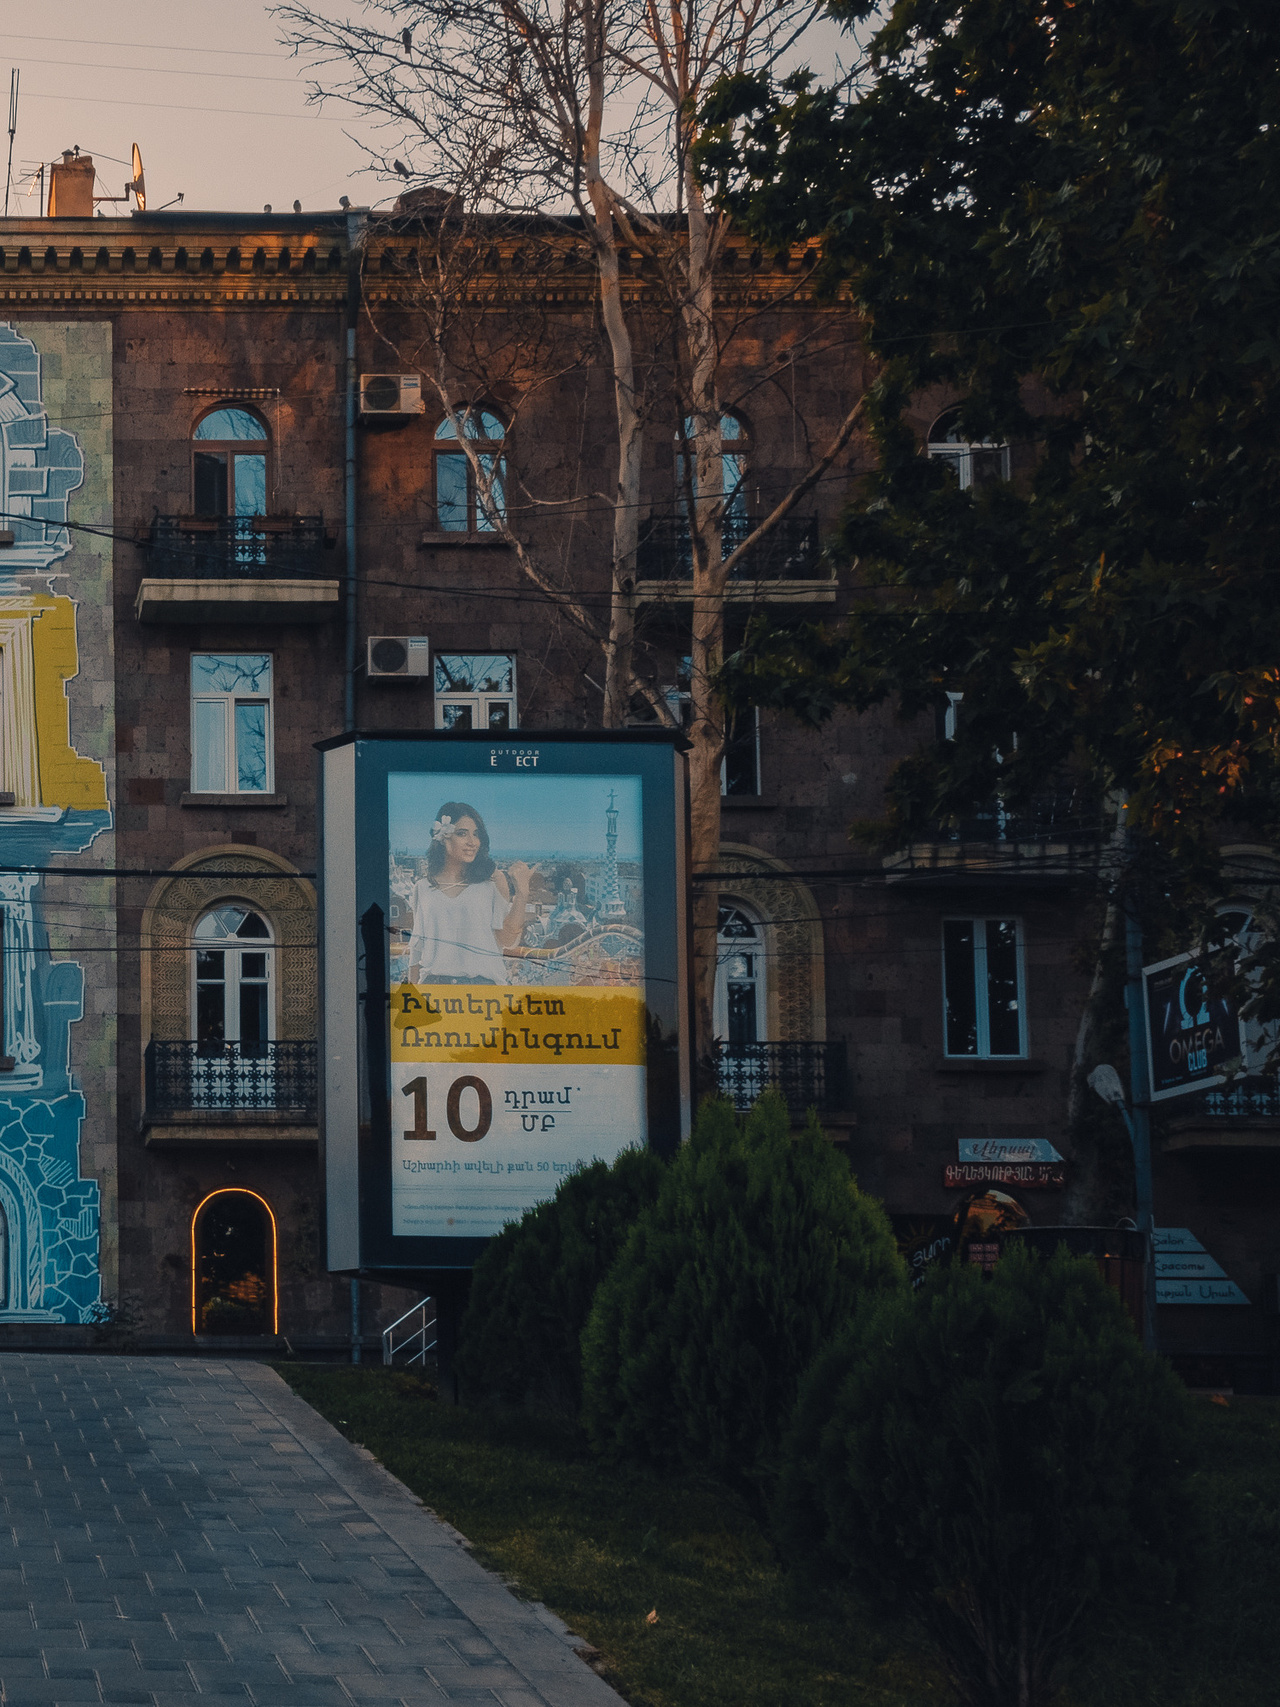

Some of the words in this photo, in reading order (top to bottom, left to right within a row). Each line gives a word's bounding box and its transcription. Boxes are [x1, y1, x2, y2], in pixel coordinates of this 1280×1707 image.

[401, 993, 565, 1021] Ինտերնետ
[400, 1025, 622, 1055] Ռոումինգում
[1169, 1026, 1225, 1064] OMEGA
[1187, 1048, 1208, 1072] CLUB
[401, 1075, 493, 1142] 10
[521, 1114, 555, 1132] ՄԲ
[402, 1160, 460, 1173] Աշխարհի
[464, 1160, 504, 1173] ավելի
[507, 1161, 533, 1174] քան
[536, 1161, 549, 1171] 50
